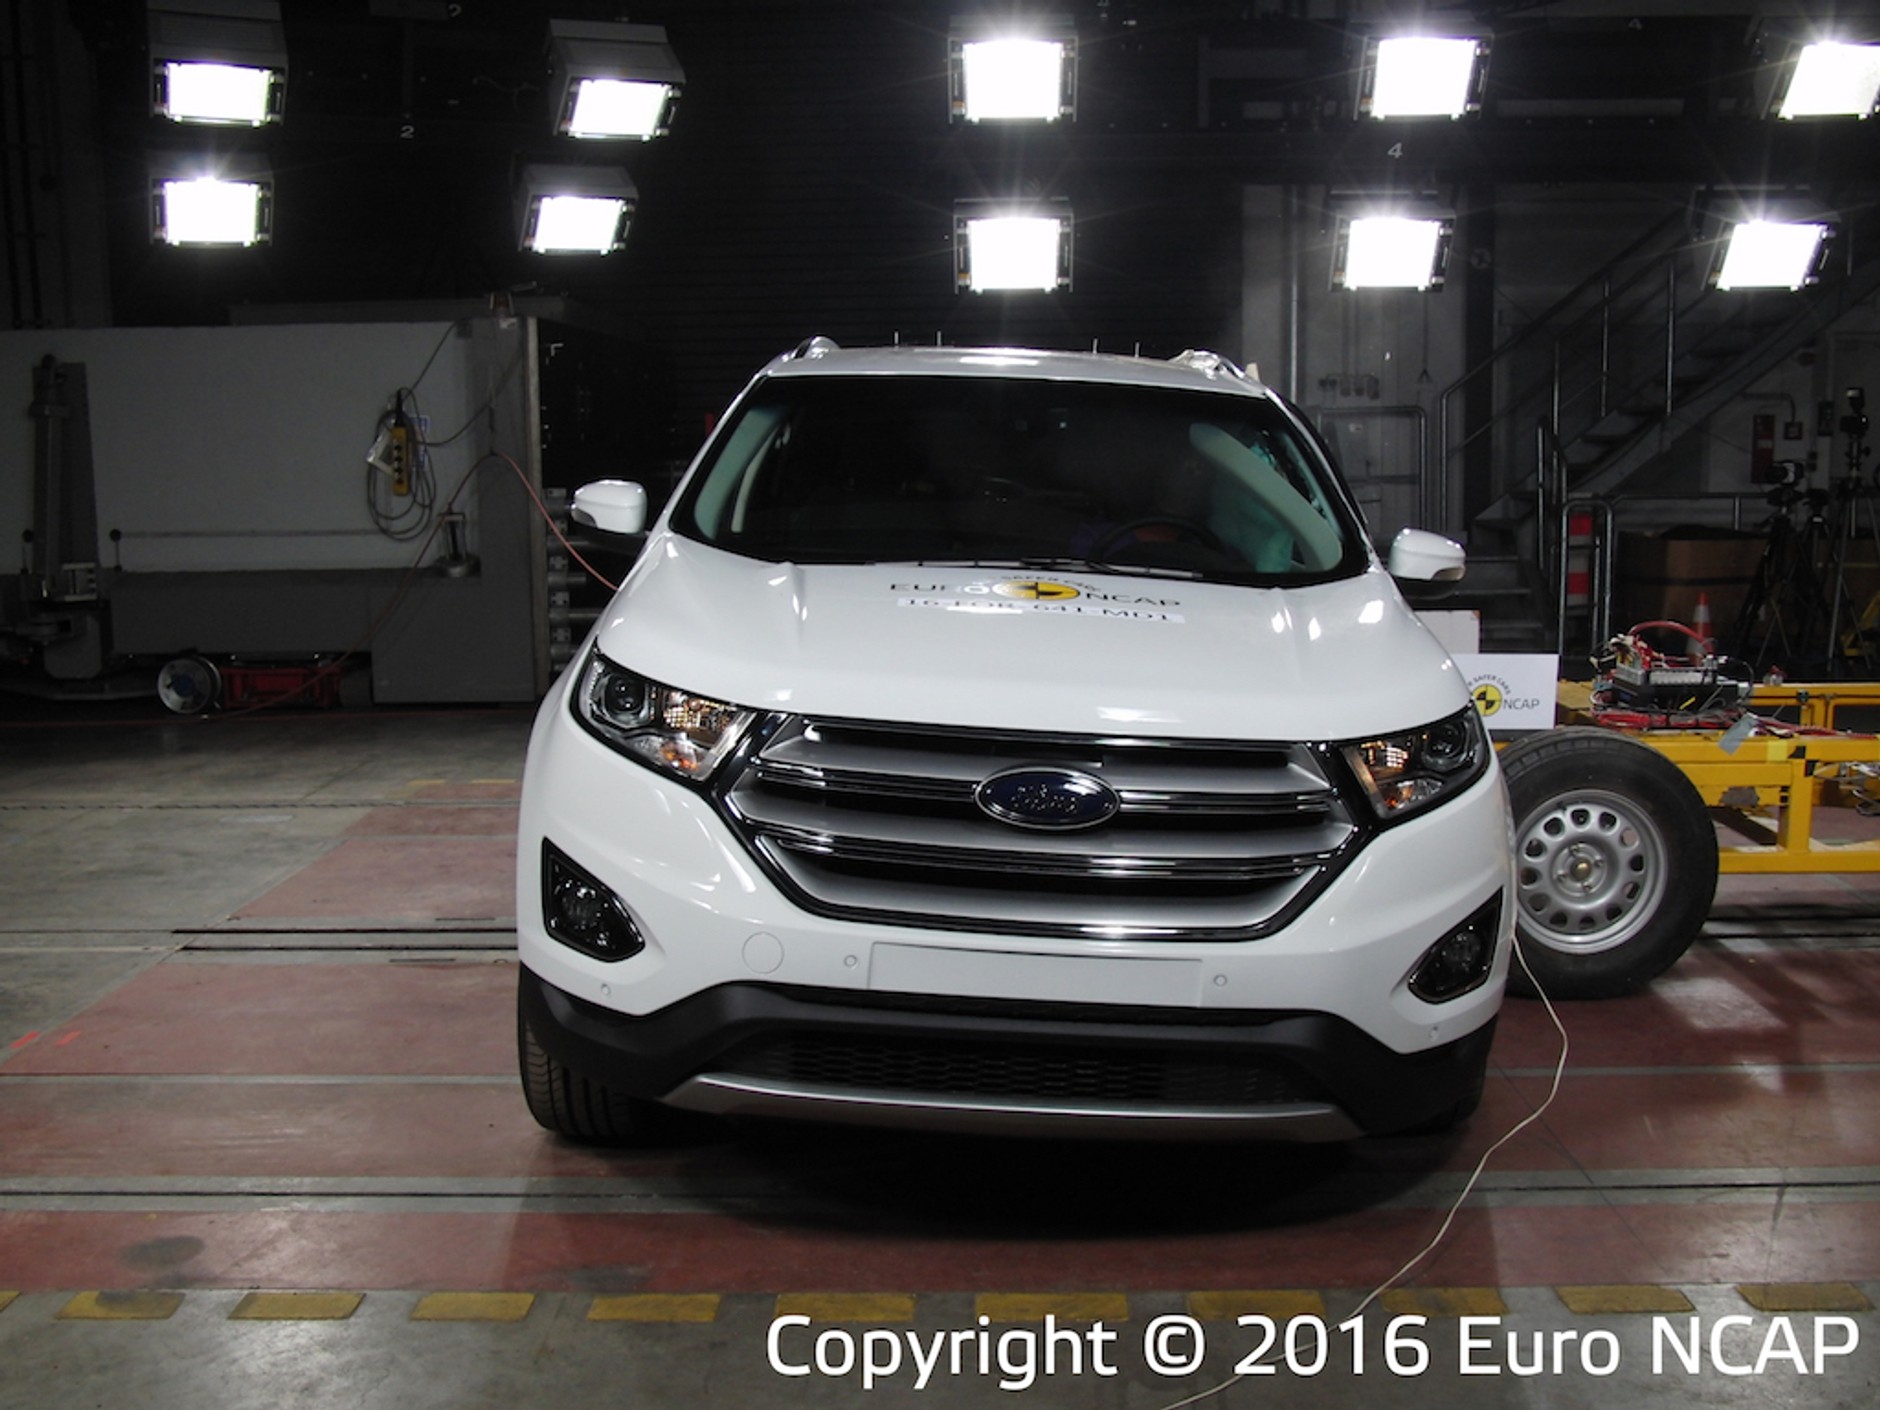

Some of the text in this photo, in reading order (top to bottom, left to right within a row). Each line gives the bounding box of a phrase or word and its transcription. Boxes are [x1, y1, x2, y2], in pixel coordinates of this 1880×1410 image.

[400, 125, 415, 139] 2
[1387, 142, 1403, 159] 4
[1086, 592, 1181, 606] NCAP
[1503, 698, 1540, 710] NCAP
